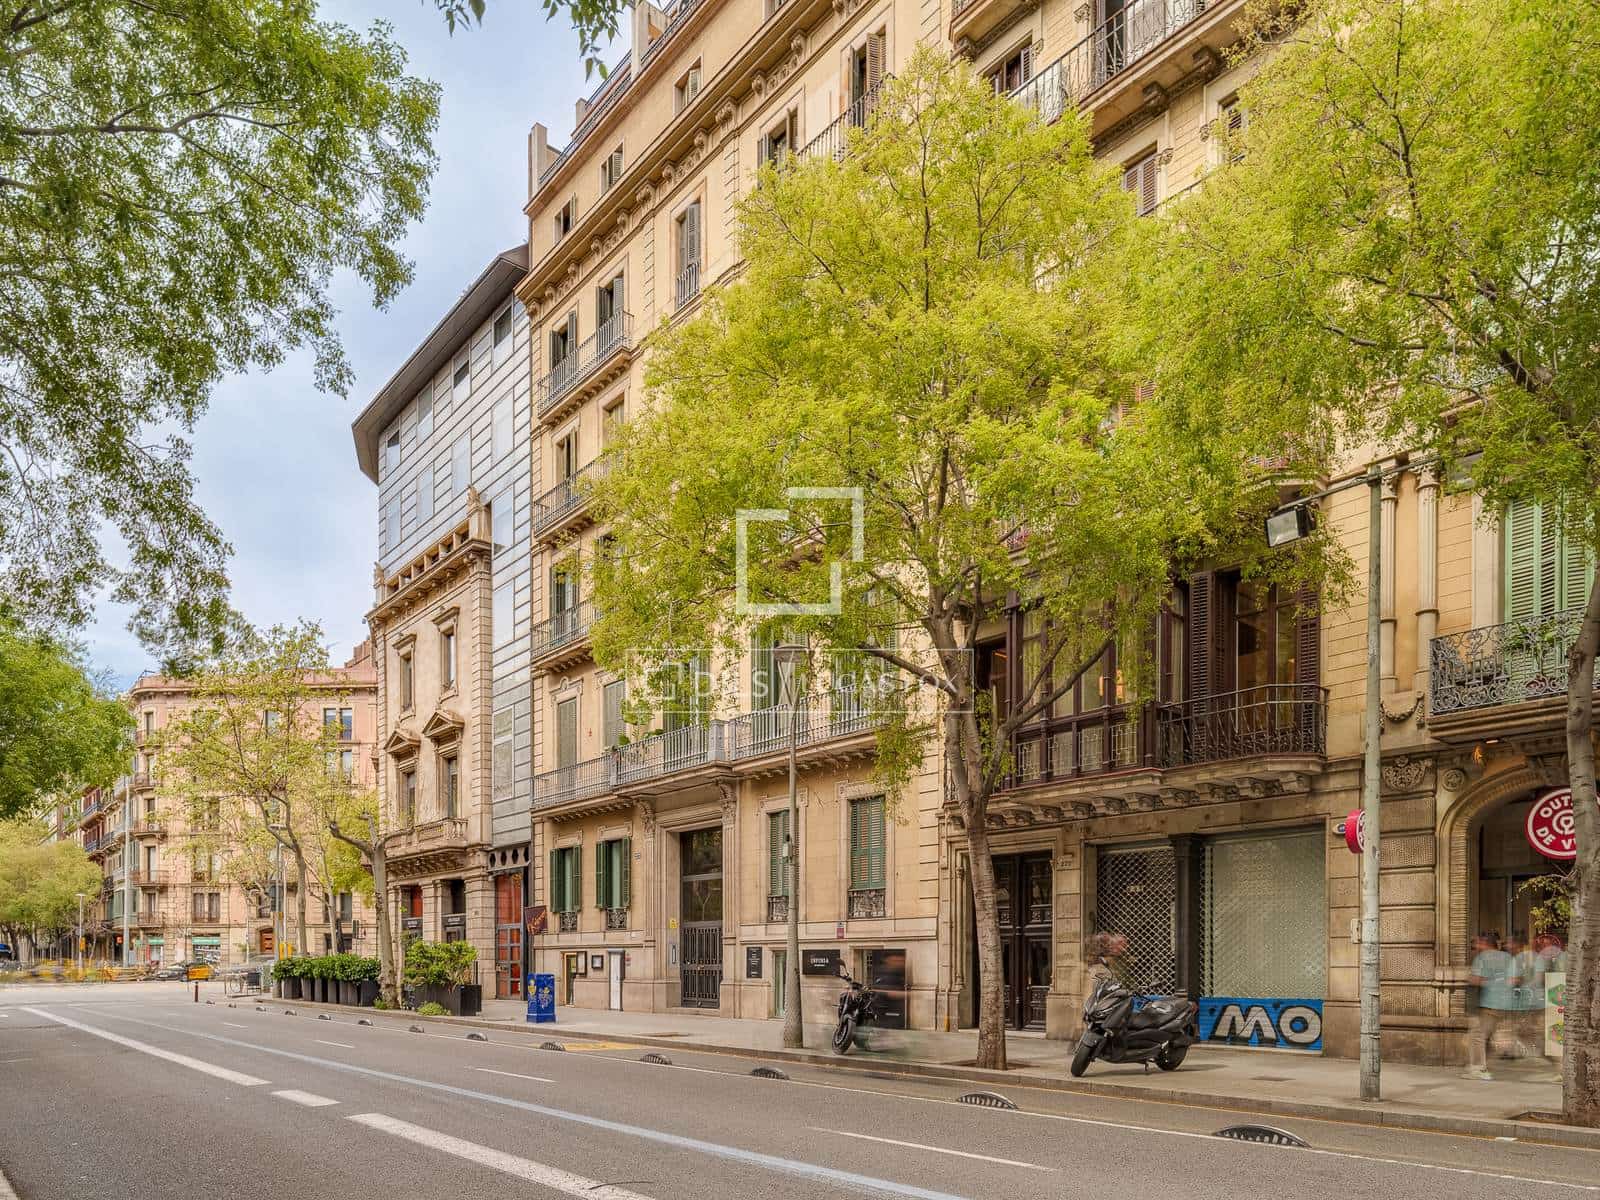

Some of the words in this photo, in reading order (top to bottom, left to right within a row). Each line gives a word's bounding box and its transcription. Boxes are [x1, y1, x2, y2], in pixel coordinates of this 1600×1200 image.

[1540, 795, 1574, 818] OUT
[1536, 826, 1556, 846] DE
[1210, 1003, 1322, 1045] MO
